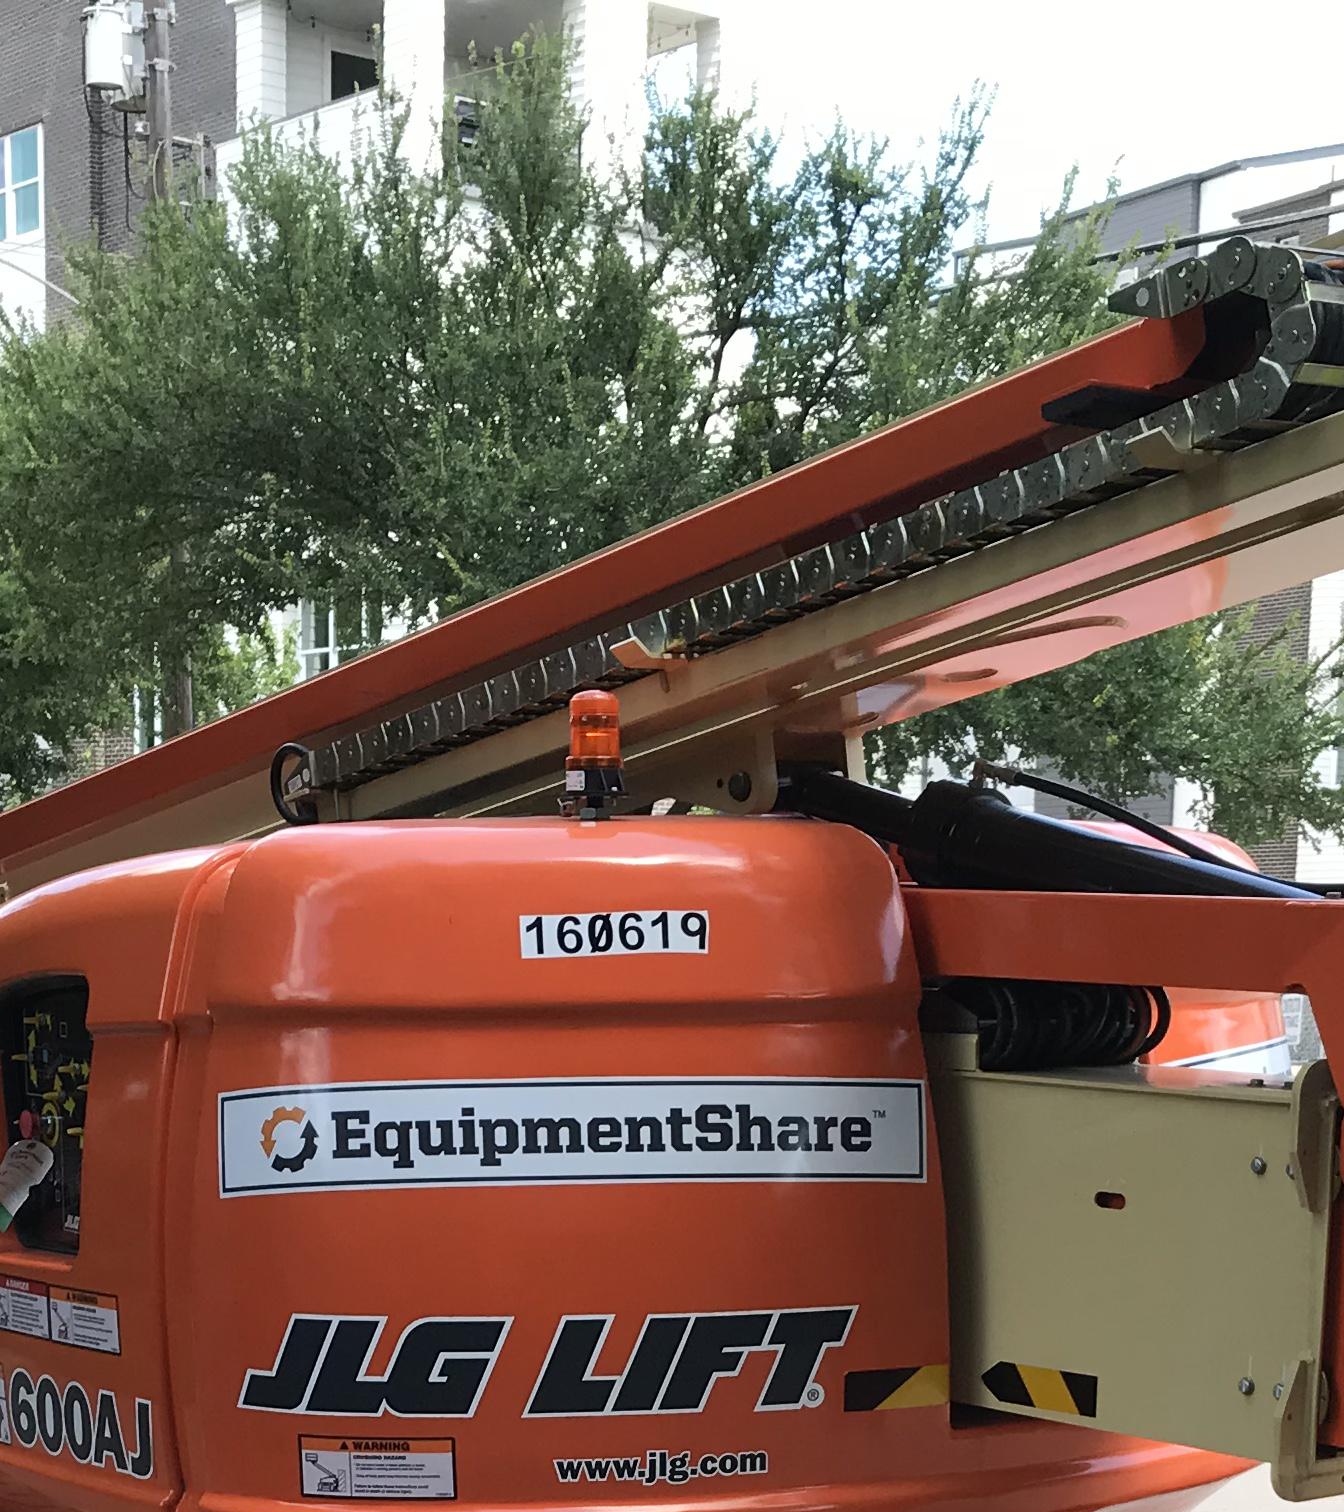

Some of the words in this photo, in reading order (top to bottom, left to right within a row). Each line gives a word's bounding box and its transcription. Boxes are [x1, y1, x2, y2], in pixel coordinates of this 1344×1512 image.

[332, 1104, 872, 1168] EquipmentShare
[238, 1313, 514, 1417] JLG
[10, 1368, 153, 1479] 600AJ
[353, 1441, 410, 1452] WARNING
[553, 1450, 769, 1486] www.jlg.com
